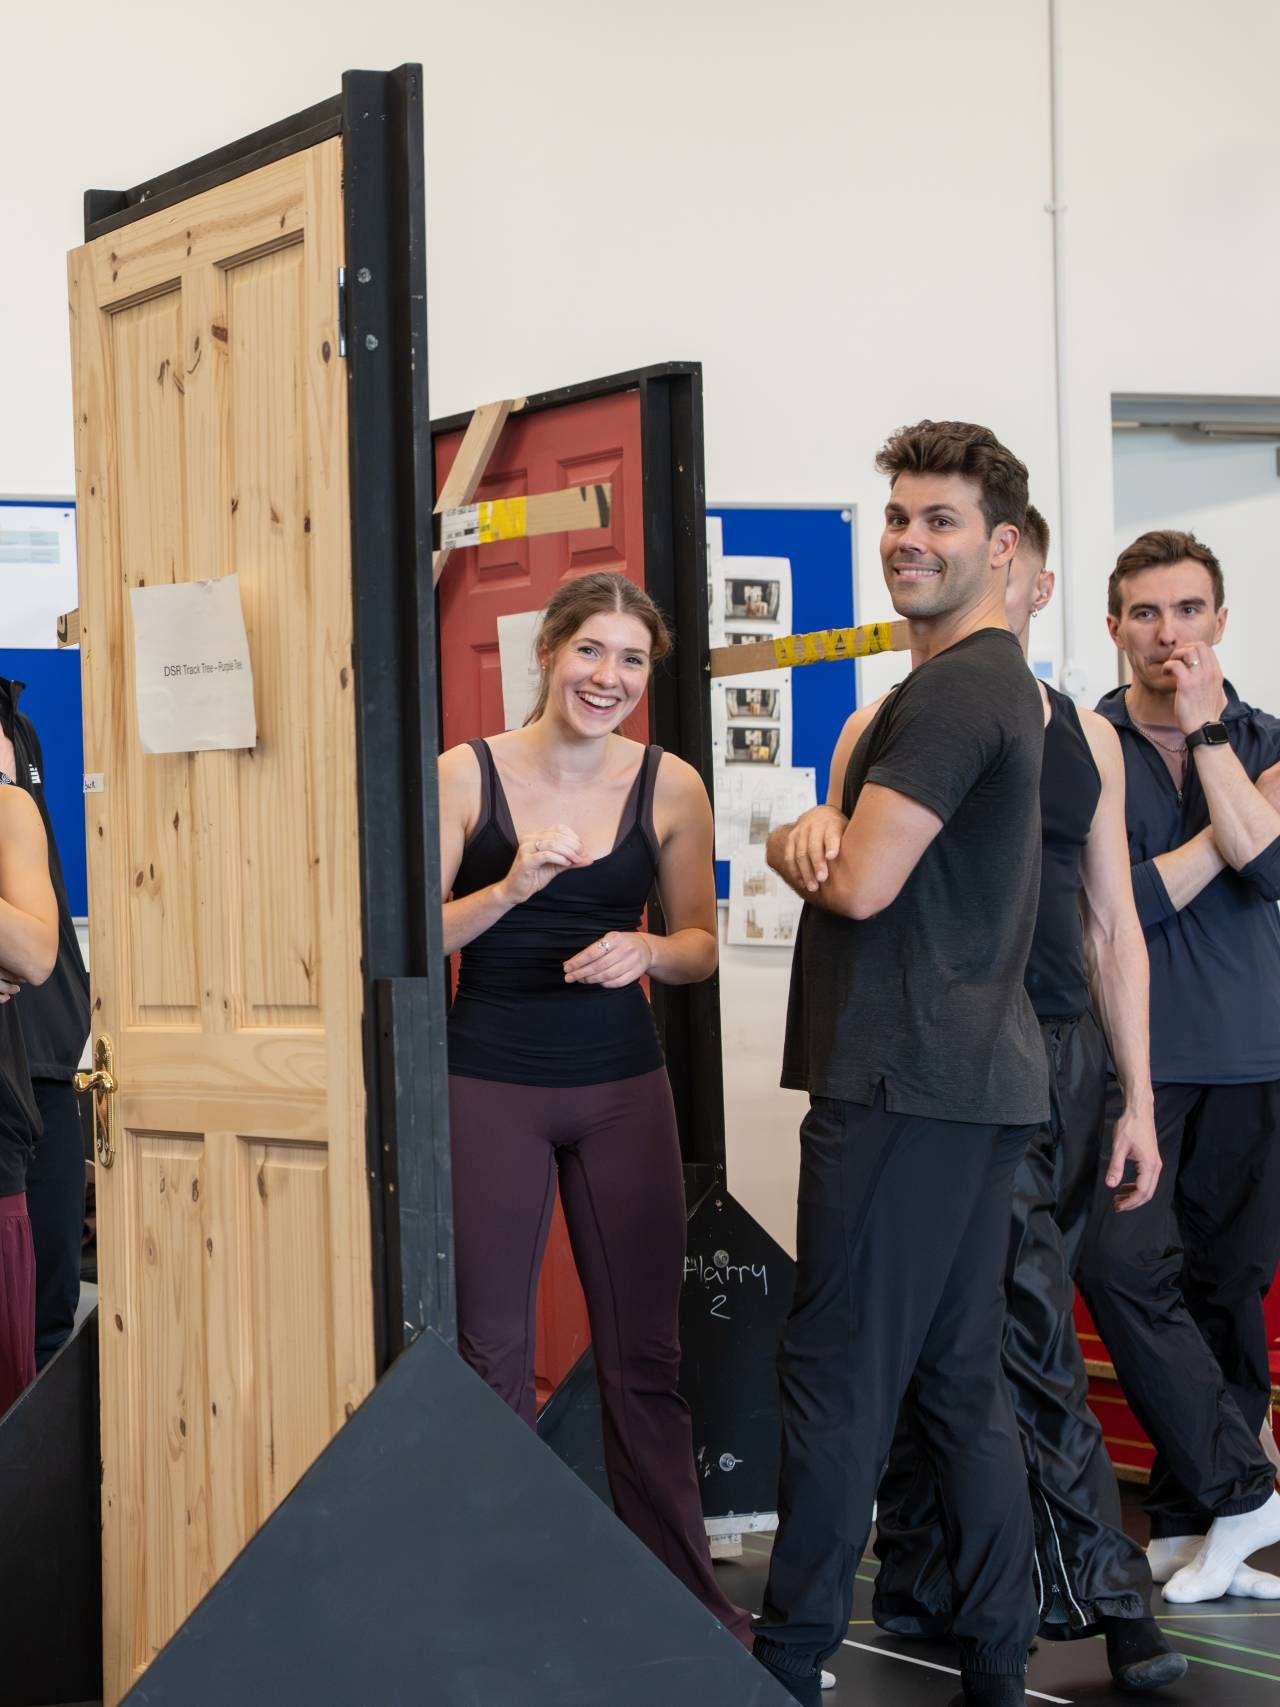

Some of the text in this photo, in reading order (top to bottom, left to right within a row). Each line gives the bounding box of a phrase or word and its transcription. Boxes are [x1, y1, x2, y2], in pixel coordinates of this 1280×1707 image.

[163, 665, 182, 677] DSR
[182, 664, 200, 676] Track
[201, 662, 214, 673] Tree
[683, 1255, 768, 1295] Harry
[710, 1294, 731, 1320] 2
